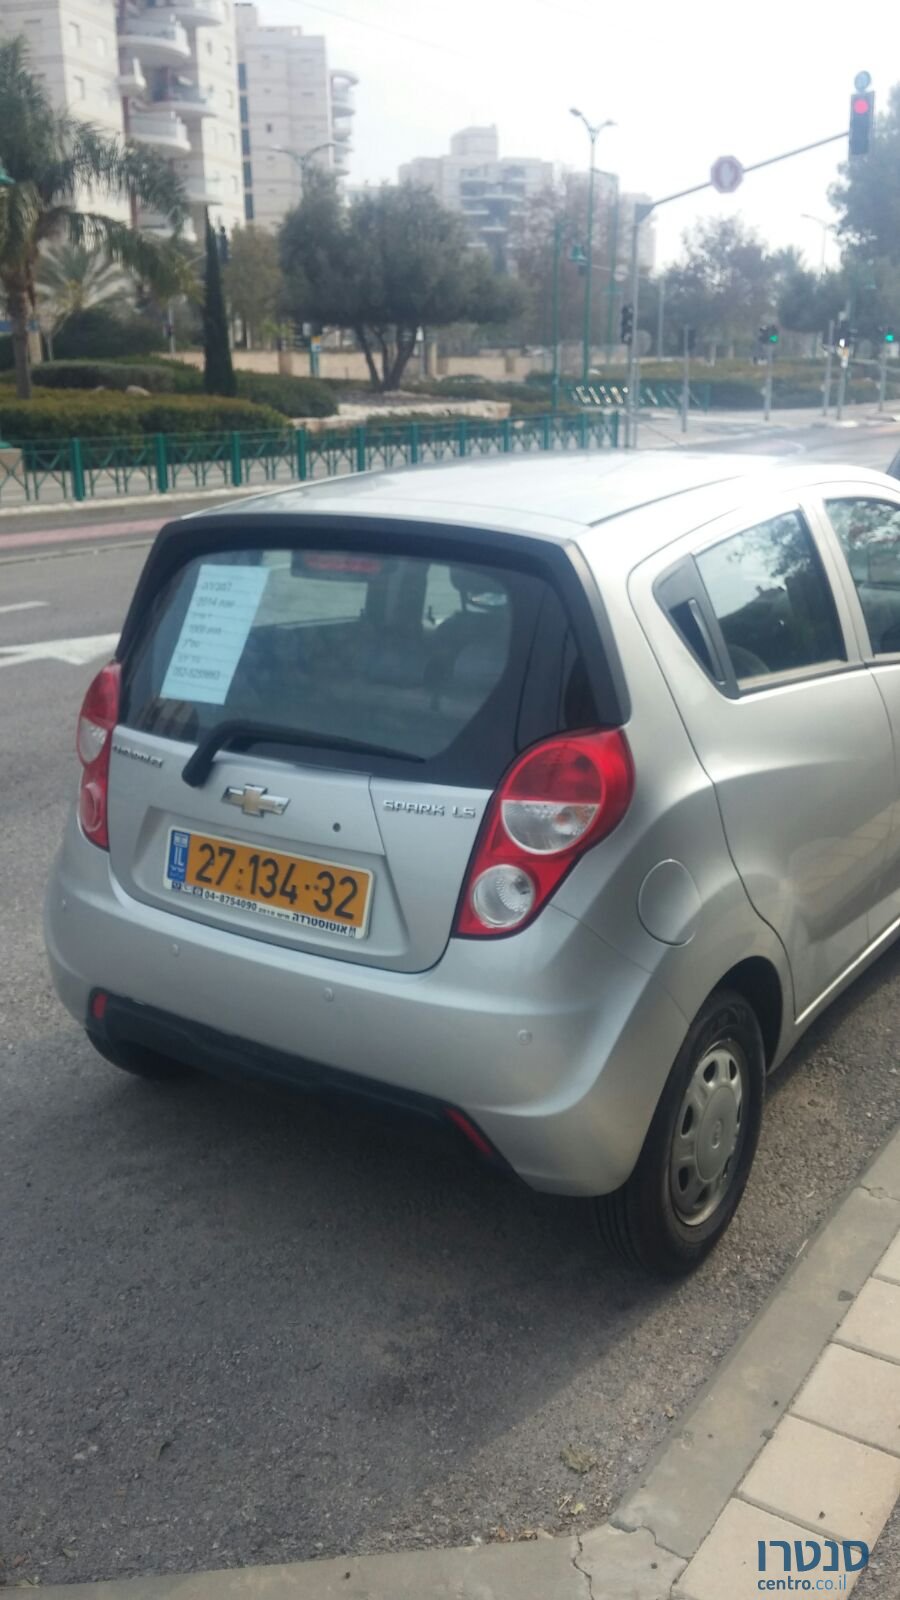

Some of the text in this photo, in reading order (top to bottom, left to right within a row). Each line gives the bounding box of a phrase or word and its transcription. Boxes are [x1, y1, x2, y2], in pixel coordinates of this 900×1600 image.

[383, 800, 476, 818] SPARK LS
[173, 847, 184, 865] IL
[204, 891, 257, 911] 04-8754090
[292, 912, 347, 935] אוטוסטרדה
